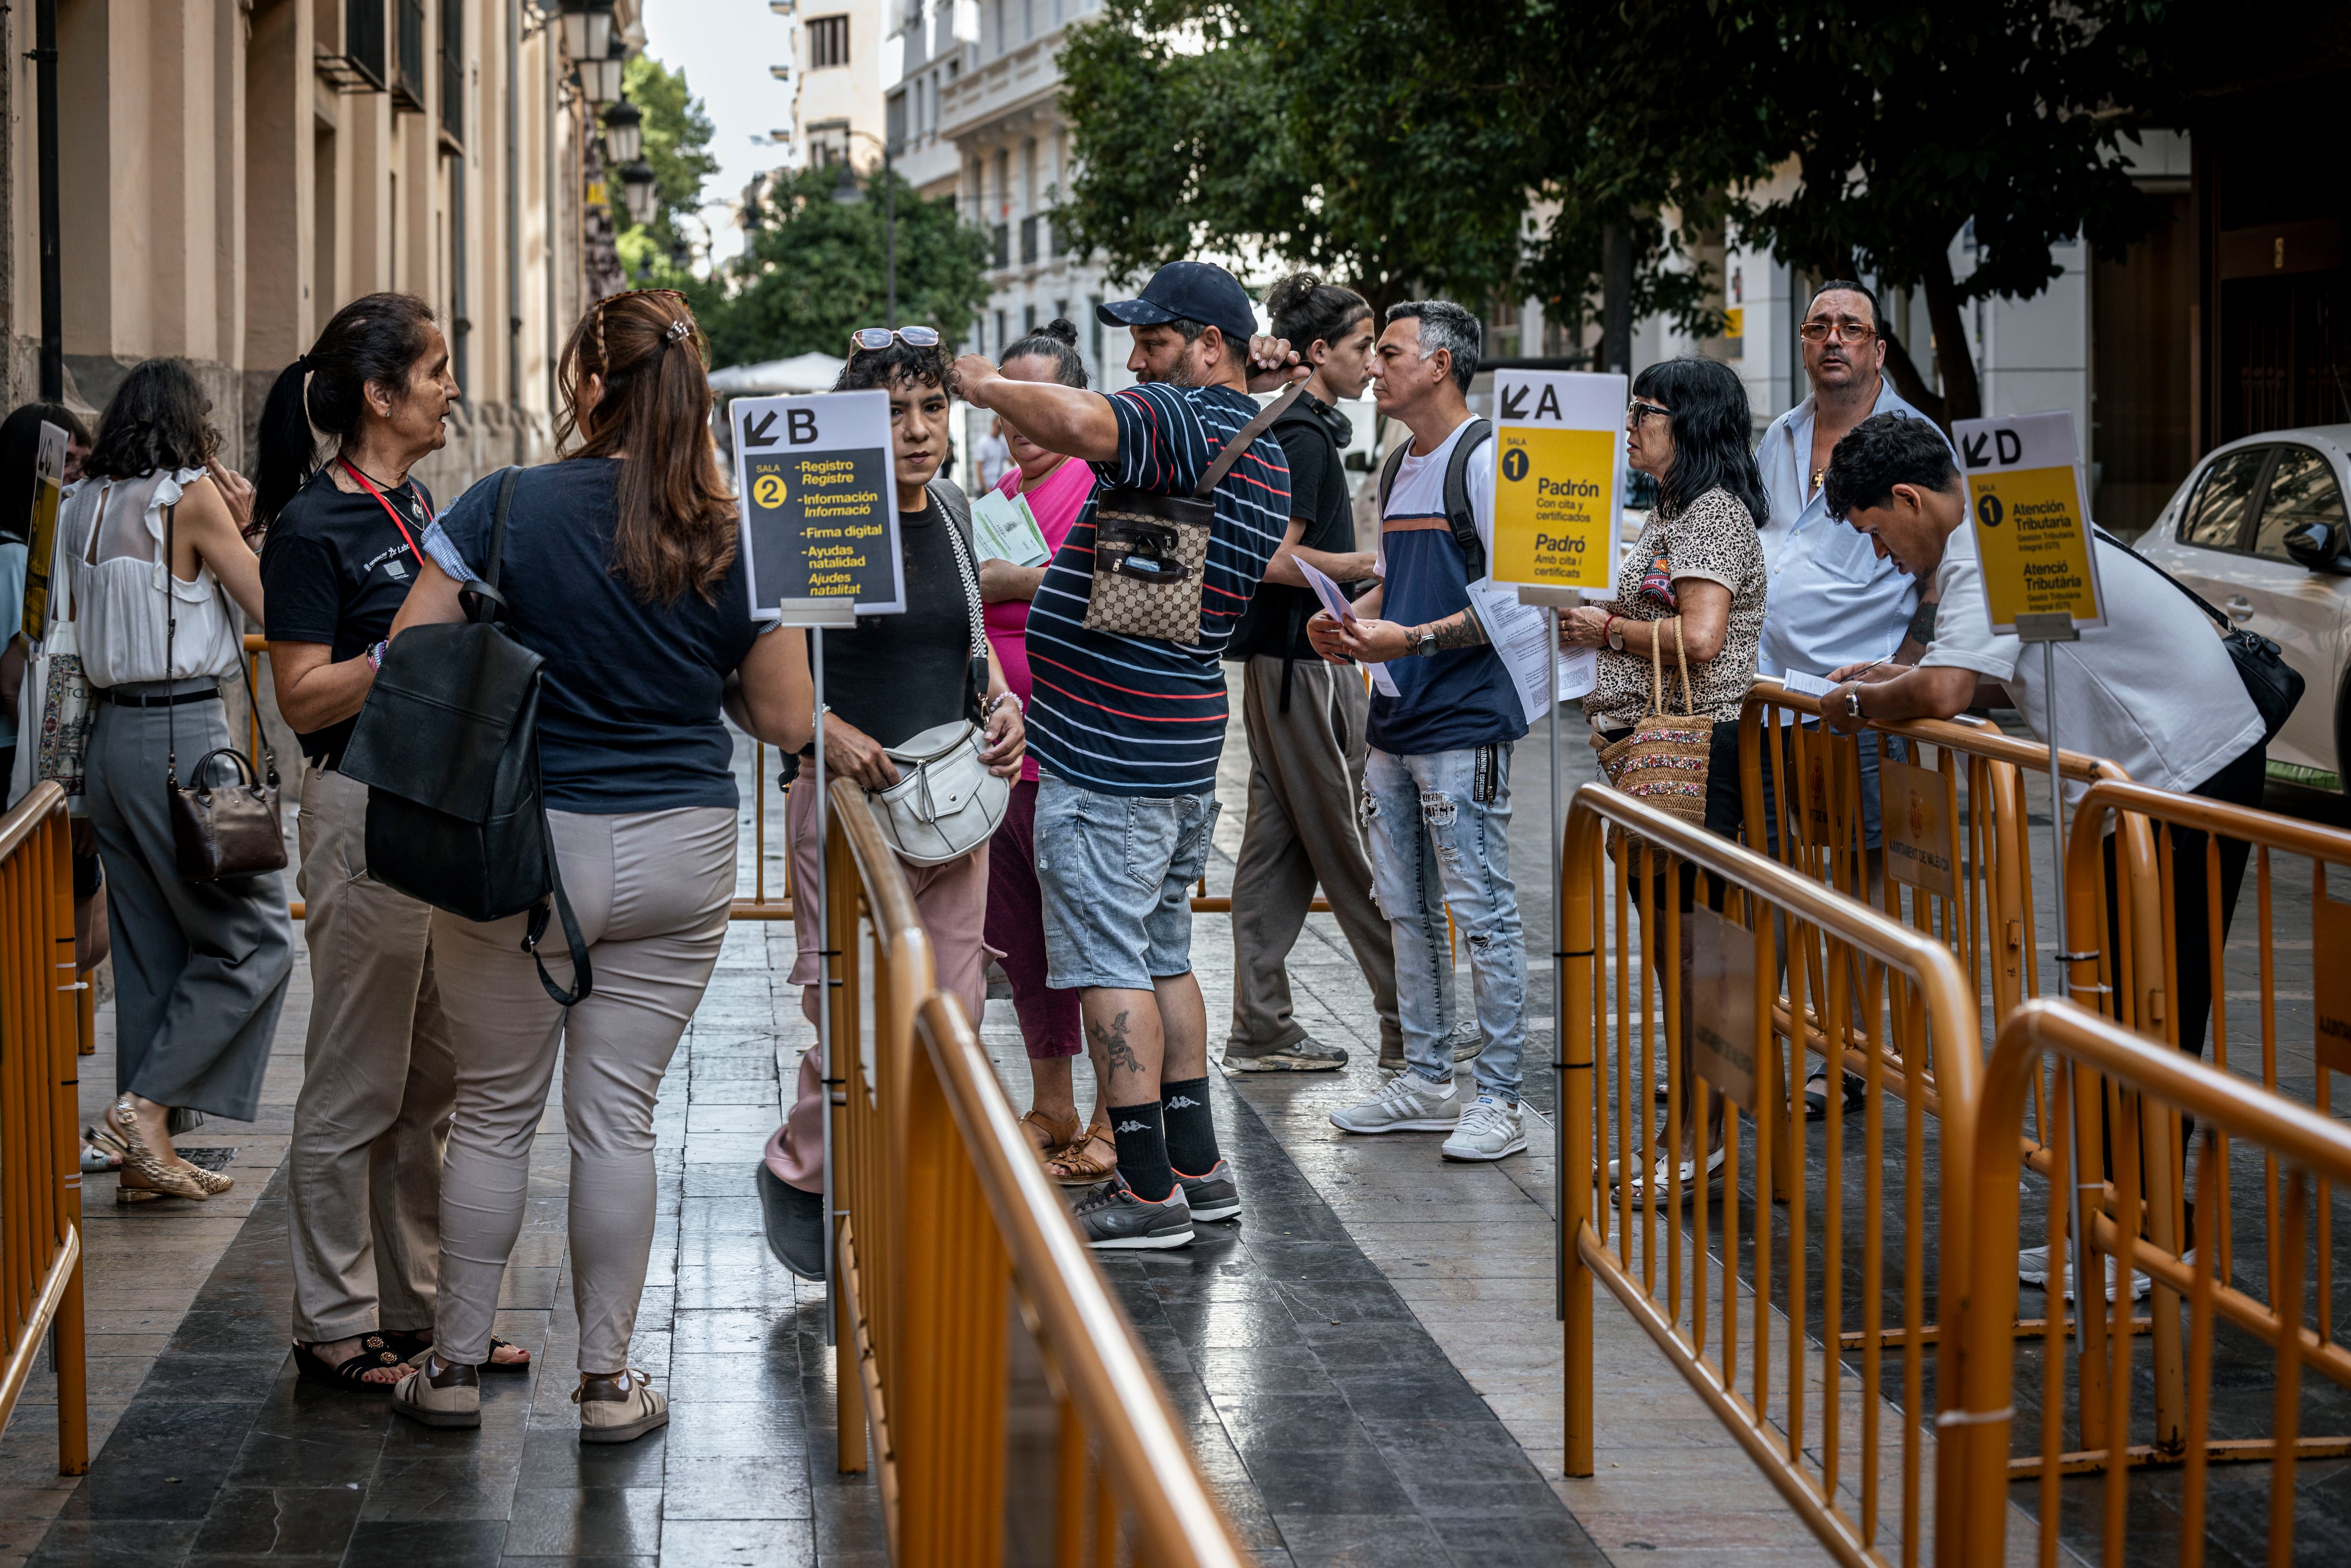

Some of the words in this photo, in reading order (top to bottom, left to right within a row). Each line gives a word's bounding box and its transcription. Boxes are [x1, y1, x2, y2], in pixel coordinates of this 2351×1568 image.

[1534, 384, 1562, 420] A
[787, 409, 818, 445] B
[1507, 437, 1527, 446] SALA
[1995, 429, 2021, 465] D
[46, 438, 52, 475] C
[756, 464, 781, 473] SALA
[1509, 453, 1519, 477] 1
[802, 473, 854, 486] Registre
[761, 479, 779, 503] 2
[1538, 478, 1599, 497] Padrón
[1978, 484, 1996, 493] SALA
[805, 504, 871, 518] Informació
[1536, 497, 1556, 509] Con
[1558, 498, 1576, 510] cita
[1578, 501, 1584, 512] y
[1983, 499, 1995, 522] 1
[2013, 500, 2065, 517] Atención
[1536, 511, 1591, 523] certificados
[2014, 515, 2072, 531] Tributaria
[844, 524, 882, 539] digital
[397, 544, 410, 554] Labo
[1535, 534, 1586, 553] Padró
[2018, 543, 2043, 552] Integral
[809, 556, 866, 569] natalidad
[1534, 554, 1557, 565] Amb
[1559, 555, 1577, 566] cita
[1534, 567, 1580, 579] certificats
[2023, 560, 2068, 576] Atenció
[808, 572, 851, 585] Ajudes
[2025, 575, 2082, 591] Tributària
[810, 583, 861, 596] natalitat
[1889, 839, 1917, 861] AJUNTAMENT
[1919, 850, 1926, 864] DE
